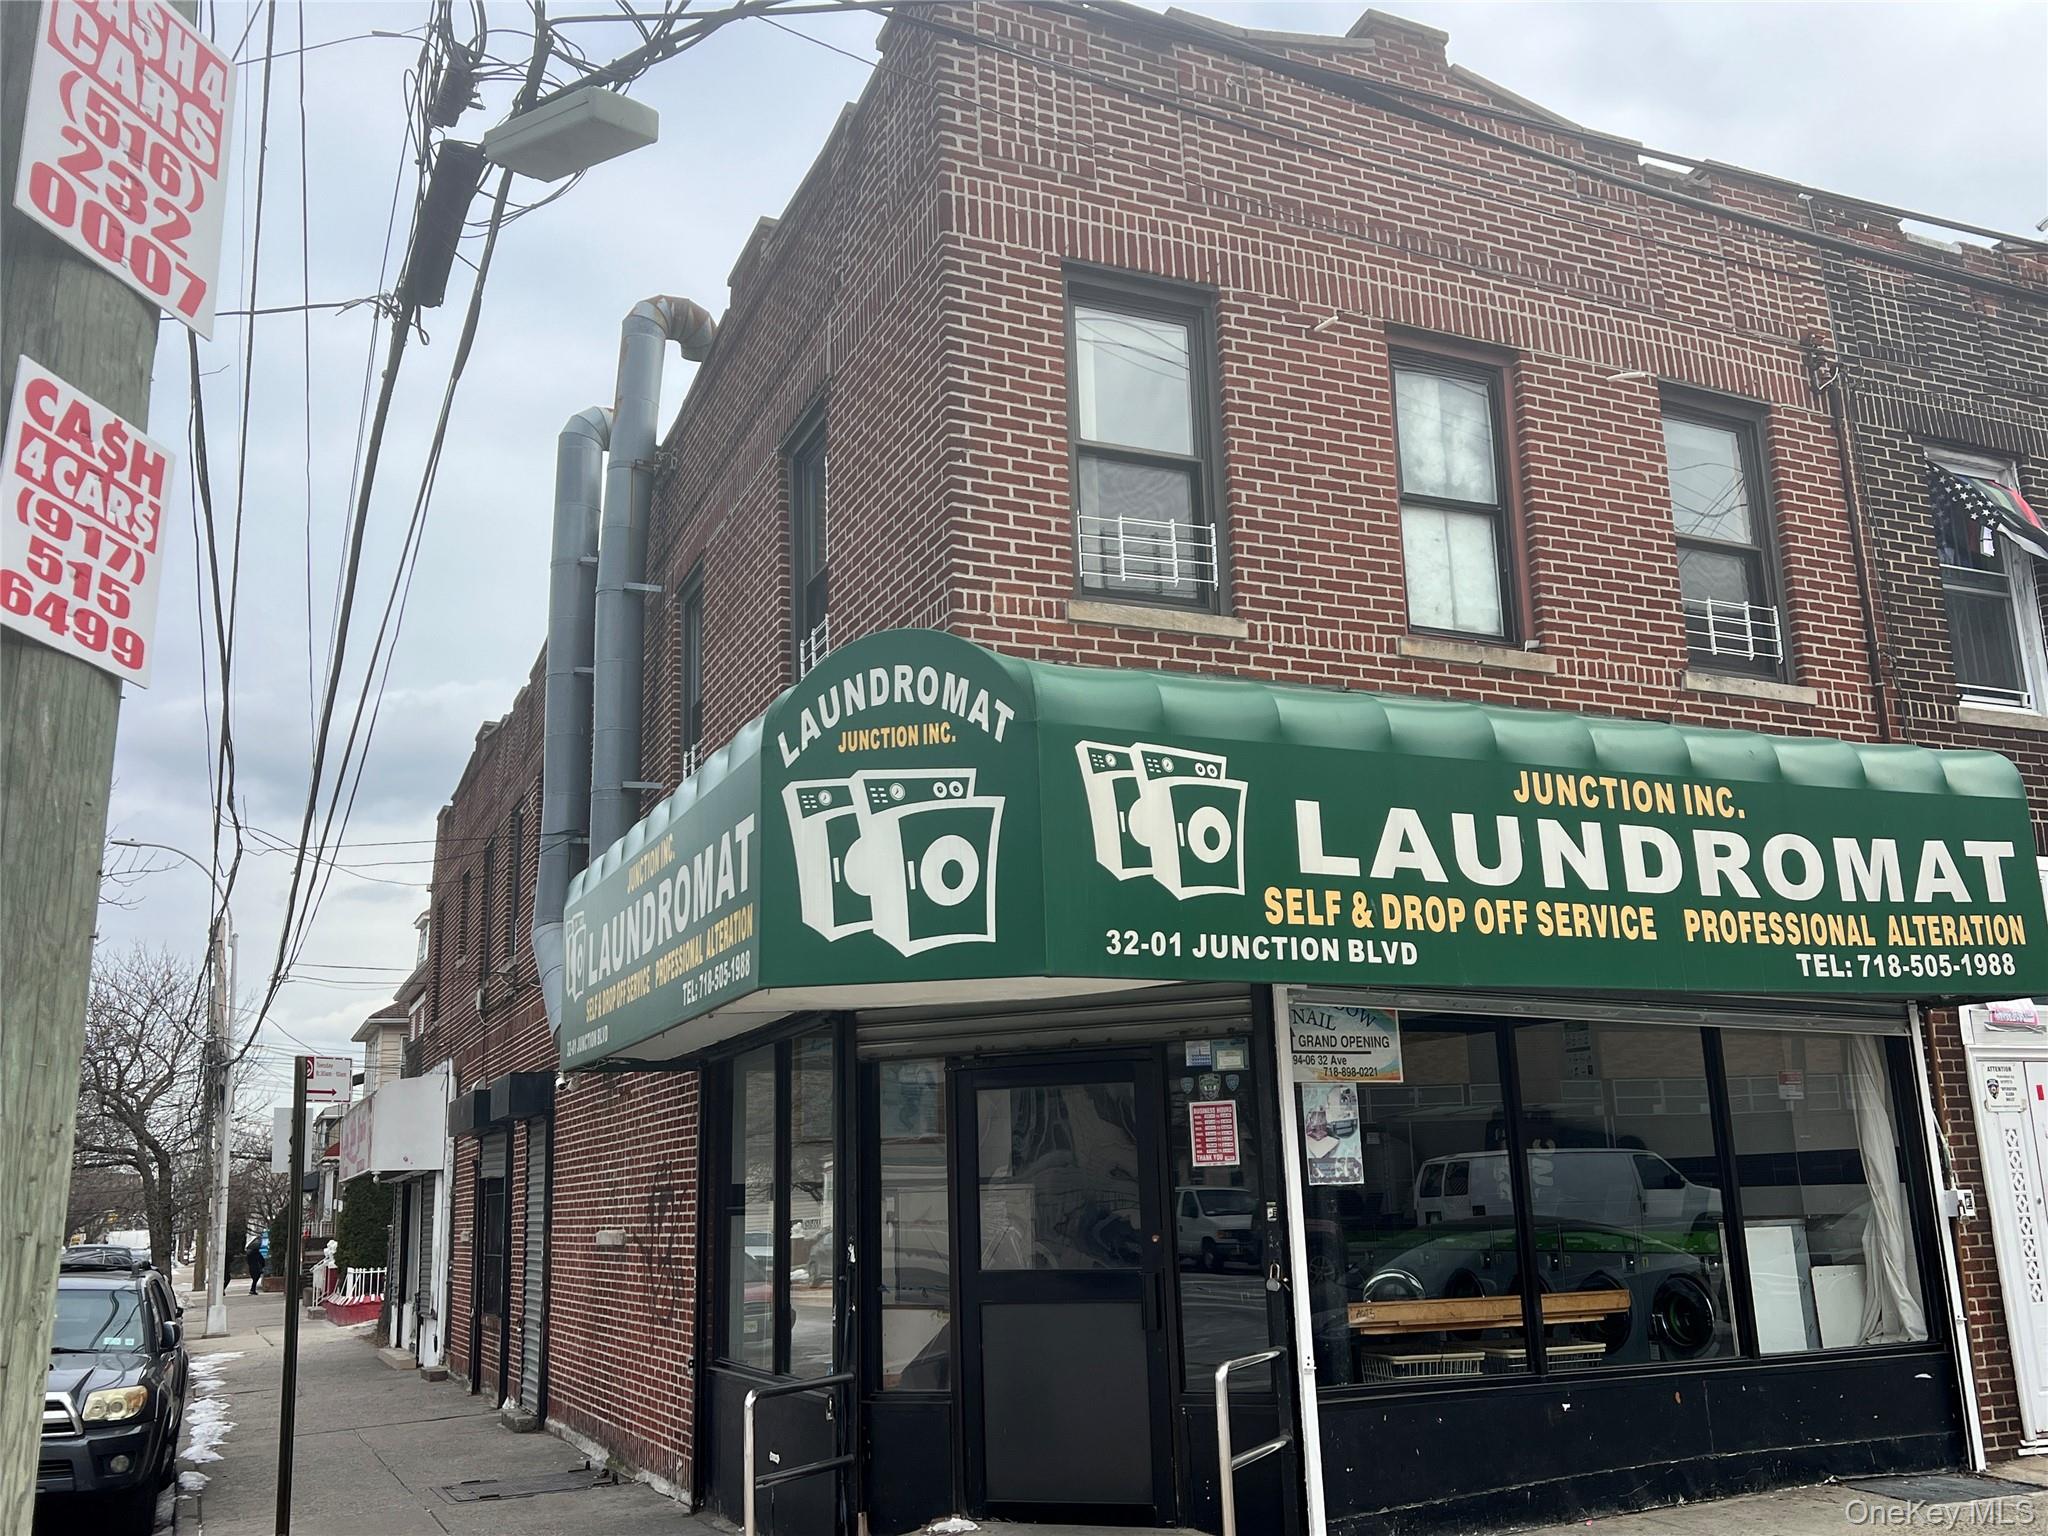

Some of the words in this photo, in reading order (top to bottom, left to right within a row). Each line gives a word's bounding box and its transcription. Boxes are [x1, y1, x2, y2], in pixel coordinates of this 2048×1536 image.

[54, 0, 216, 166] CARS
[59, 70, 205, 214] (516)
[57, 126, 192, 261] 232
[28, 161, 207, 319] 0007
[16, 486, 146, 586] (917)
[26, 534, 131, 620] 515
[0, 568, 145, 670] 6499
[777, 664, 1016, 769] LAUNDROMAT
[838, 724, 919, 753] JUNCTION
[923, 721, 957, 745] INC.
[1513, 770, 1676, 815] JUNCTION
[1682, 783, 1746, 819] INC.
[627, 844, 660, 894] JUNCTION
[660, 832, 676, 871] INC.
[1295, 799, 2015, 903] LAUNDROMAT
[588, 813, 755, 988] LAUNDROMAT
[1264, 886, 1342, 926] SELF
[1351, 890, 1375, 929] &
[1381, 893, 1466, 933] DROP
[1474, 897, 1528, 935] OFF
[1535, 900, 1658, 941] SERVICE
[1683, 908, 1877, 947] PROFESSIONAL
[1888, 914, 2027, 947] ALTERATION
[627, 965, 650, 1004] SERVICE
[655, 934, 704, 989] PROFESSIONAL
[705, 904, 753, 960] ALTERATION
[1106, 929, 1182, 957] 32-01
[1192, 933, 1339, 962] JUNCTION
[1347, 938, 1418, 965] BLVD
[1796, 953, 1853, 978] TEL:
[1857, 953, 2016, 978] 718-505-1988
[682, 978, 698, 1007] TEL:
[698, 950, 751, 1000] 718-505-1988
[1291, 1008, 1337, 1031] NAIL
[1298, 1034, 1338, 1048] GRAND
[1341, 1035, 1390, 1048] OPENING
[1293, 1055, 1316, 1066] 94-06
[1317, 1055, 1328, 1065] 32
[1330, 1055, 1347, 1066] Ave
[1323, 1066, 1378, 1078] 718-898-0221
[1193, 1106, 1216, 1115] BUSINESS
